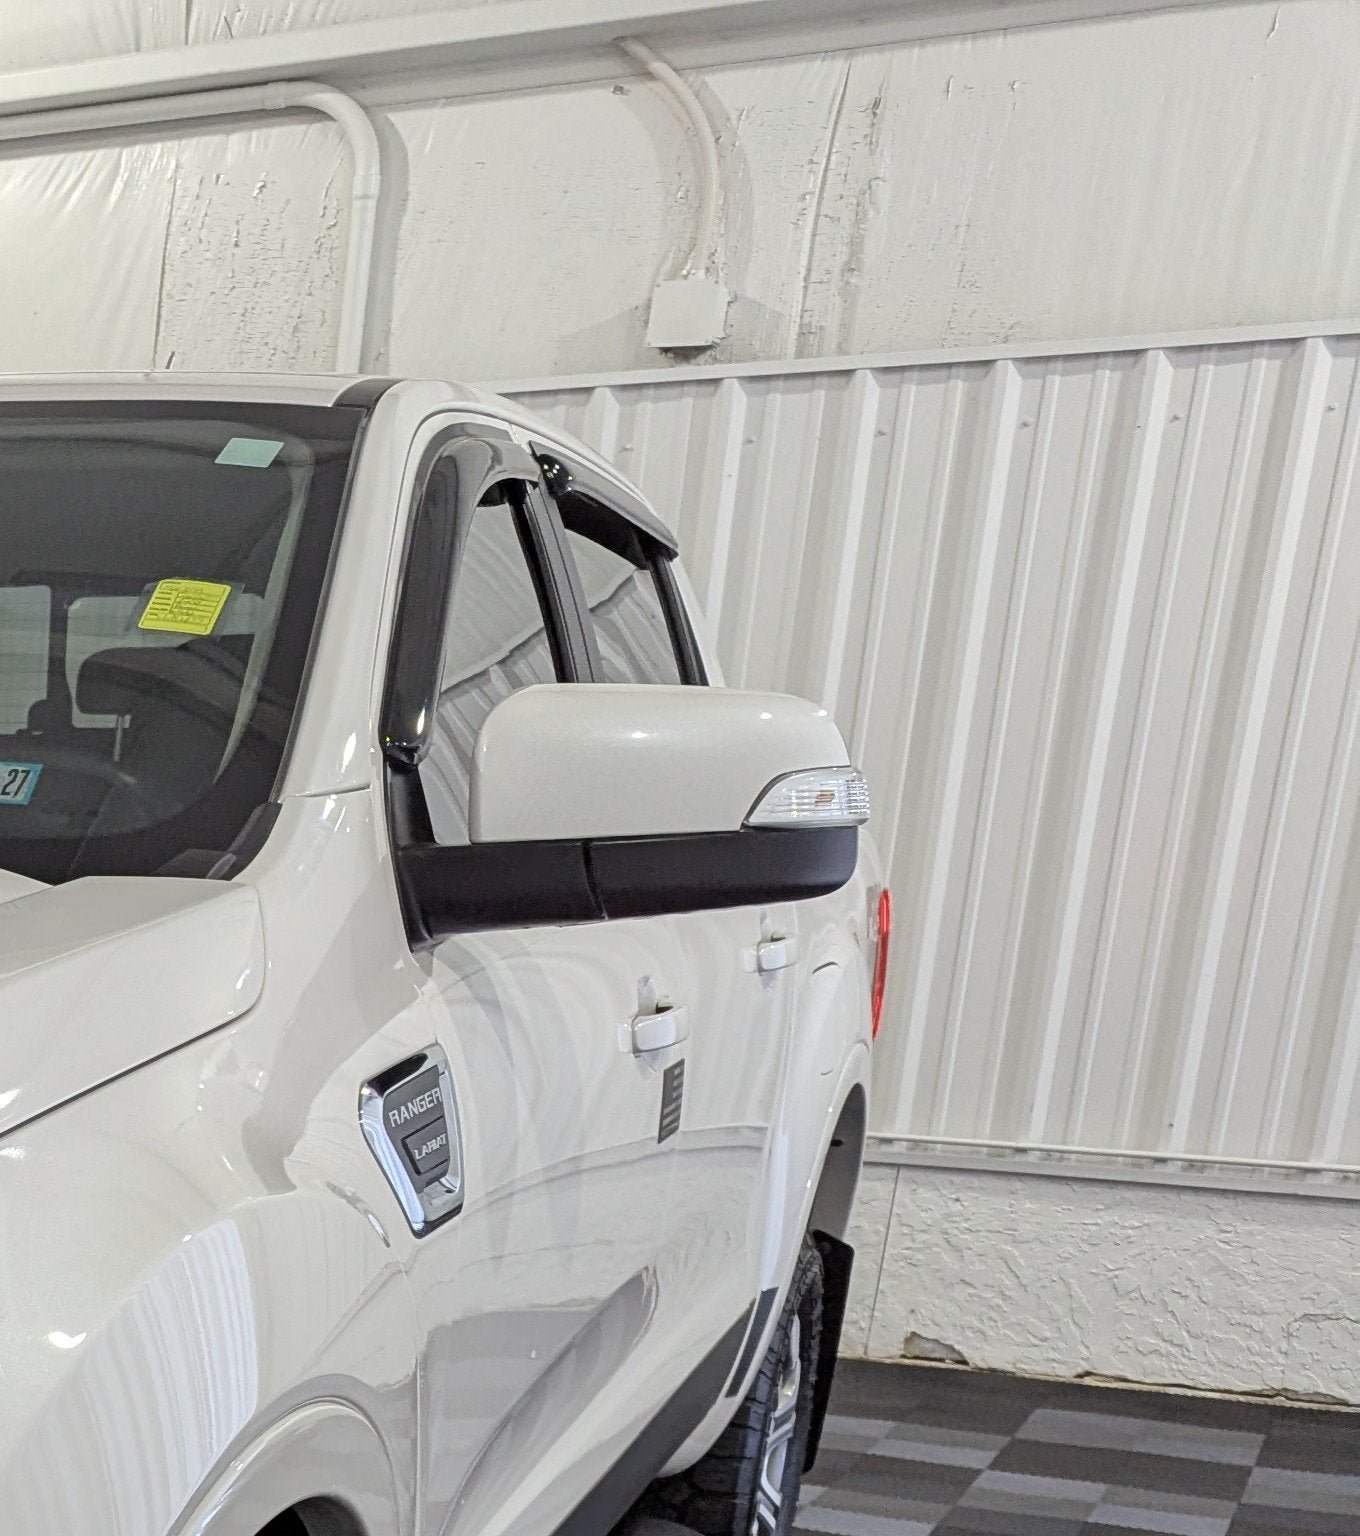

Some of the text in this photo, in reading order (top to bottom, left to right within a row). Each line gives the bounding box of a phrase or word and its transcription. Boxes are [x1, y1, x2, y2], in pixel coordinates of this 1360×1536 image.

[0, 768, 31, 798] 27
[388, 1087, 442, 1128] RANGER
[414, 1133, 447, 1160] LARIAT
